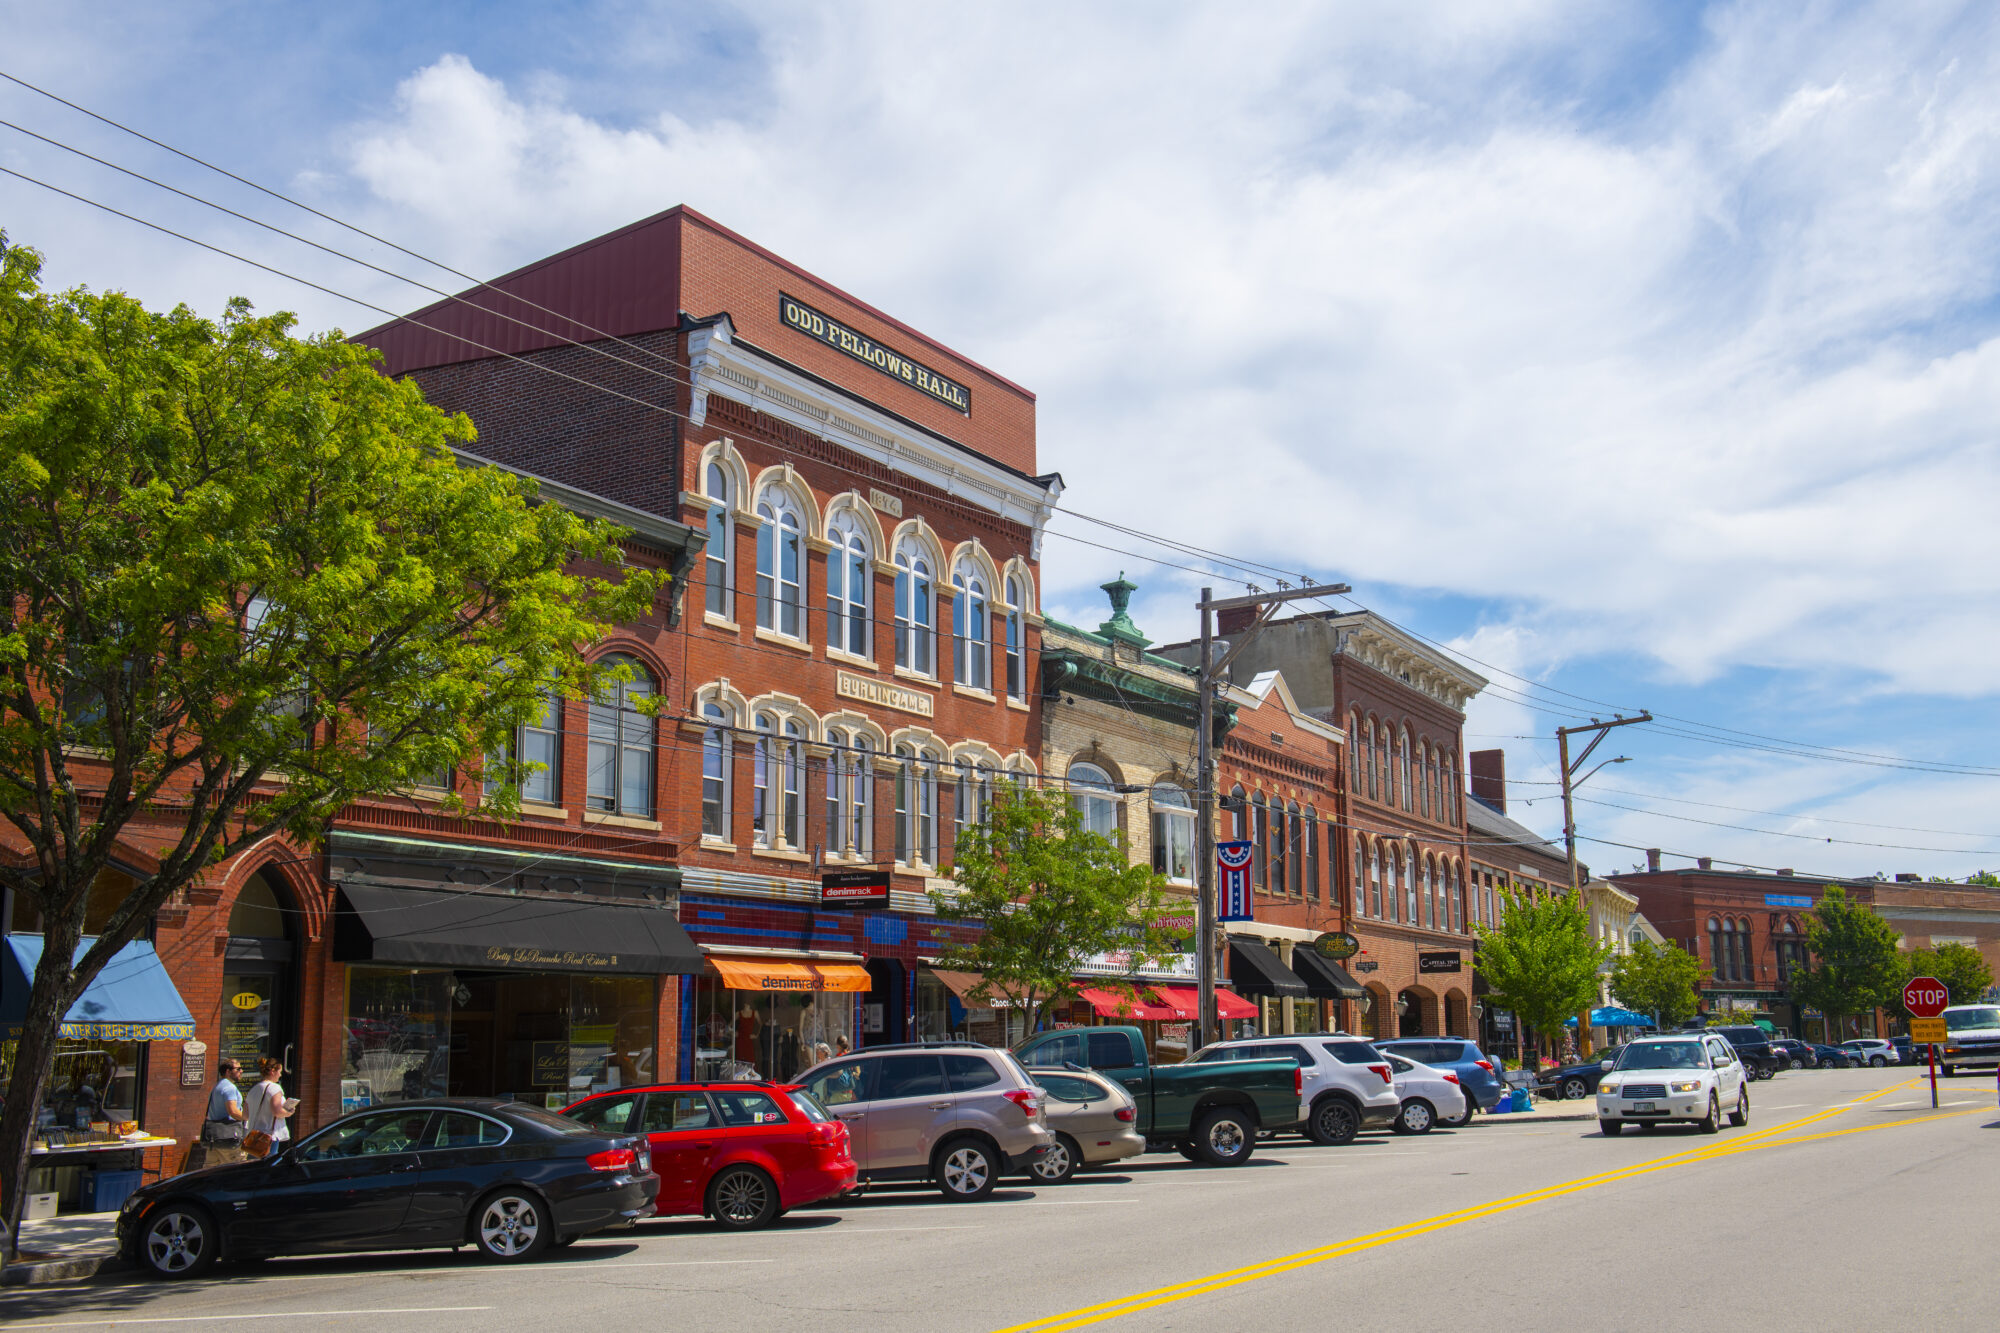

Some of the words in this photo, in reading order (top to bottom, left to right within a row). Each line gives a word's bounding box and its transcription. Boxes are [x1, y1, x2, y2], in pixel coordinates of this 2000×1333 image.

[786, 303, 823, 336] ODD
[828, 323, 912, 381] FELLOWS
[915, 367, 967, 408] HALL.
[826, 886, 872, 897] denimrack
[487, 946, 512, 966] Betty
[513, 947, 562, 963] LaBranche
[562, 951, 585, 965] Real
[585, 953, 609, 967] Estate
[238, 995, 255, 1007] 117
[1907, 989, 1945, 1005] STOP
[93, 1024, 130, 1037] STREET
[132, 1023, 194, 1038] BOOKSTORE
